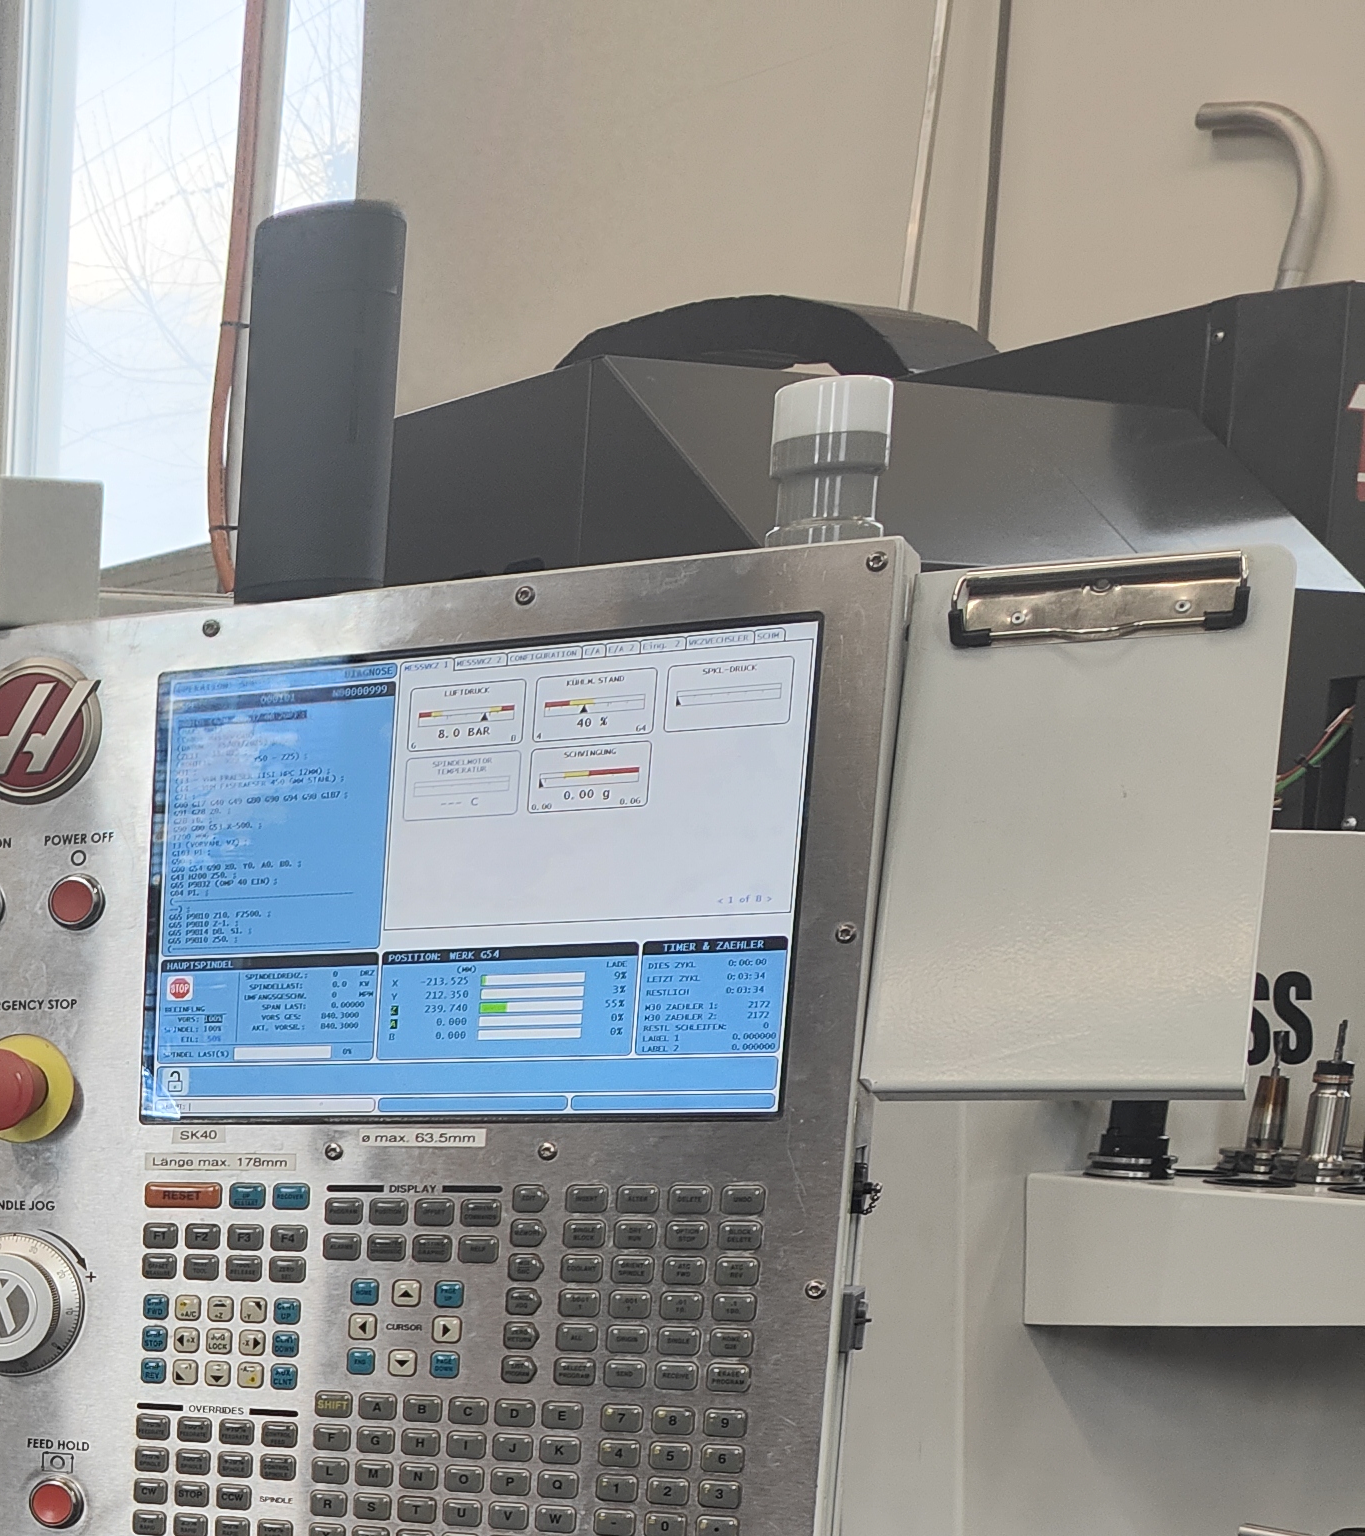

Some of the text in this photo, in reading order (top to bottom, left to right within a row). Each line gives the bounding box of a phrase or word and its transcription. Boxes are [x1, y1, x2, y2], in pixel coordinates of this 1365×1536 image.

[509, 650, 577, 662] CONFIGURATION
[344, 666, 393, 679] DIAGNOSE
[702, 664, 758, 675] SPKL-DRUCK
[598, 675, 625, 683] STAND
[444, 687, 490, 697] LUFTDRUCK
[577, 716, 608, 727] 40 %
[437, 727, 490, 739] 8.0 BAR
[563, 747, 617, 759] SCHWINGUNG
[432, 757, 492, 768] SPINDELMOTOR
[437, 766, 487, 775] TEMPERATUR
[564, 789, 610, 800] 0.00 g
[531, 803, 552, 811] 0.00
[619, 798, 641, 806] 0.06
[44, 831, 114, 847] POWER OFF
[663, 940, 764, 952] TIMER & ZAEHLER
[388, 950, 499, 962] POSITION: WERK G54
[167, 960, 233, 970] HAUPTSPINDEL
[648, 961, 696, 970] DIES ZYKL
[728, 958, 767, 967] 0:00:00
[614, 971, 627, 980] 9%
[647, 975, 673, 983] LETZT
[727, 973, 766, 981] 0:03:34
[392, 979, 398, 987] X
[421, 977, 469, 986] -213.525
[169, 983, 189, 994] STOP
[613, 985, 626, 994] 3%
[726, 986, 764, 994] 0:03:34
[391, 993, 398, 1001] Y
[425, 990, 469, 999] 212.350
[47, 998, 78, 1010] STOP
[284, 1002, 306, 1010] LAST:
[424, 1004, 468, 1013] 239.740
[605, 999, 625, 1008] 55%
[748, 1001, 770, 1009] 2172
[320, 1011, 359, 1019] 840.3000
[611, 1013, 624, 1022] 0%
[747, 1011, 770, 1019] 2172
[320, 1021, 359, 1030] 840.3000
[436, 1017, 467, 1026] 0.000
[435, 1031, 466, 1040] 0.000
[610, 1027, 623, 1036] 0%
[642, 1045, 668, 1053] LABEL
[179, 1129, 218, 1141] SK40
[374, 1133, 410, 1144] max.
[415, 1132, 476, 1143] 63.5mm
[152, 1157, 288, 1168] Länge max. 178mm
[388, 1184, 437, 1194] DISPLAY
[162, 1190, 201, 1200] RESET
[28, 1200, 56, 1212] JOG
[153, 1230, 167, 1241] F1
[194, 1232, 209, 1242] F2
[237, 1232, 251, 1243] F3
[280, 1233, 295, 1243] F4
[385, 1323, 423, 1332] CURSOR
[208, 1342, 228, 1351] LOCK
[188, 1404, 245, 1416] OVERRIDES
[317, 1400, 348, 1410] SHIFT
[372, 1402, 382, 1412] A
[417, 1404, 427, 1414] B
[463, 1406, 473, 1417] C
[509, 1408, 520, 1419] D
[557, 1410, 567, 1421] E
[617, 1412, 626, 1424] 7
[668, 1415, 677, 1426] 8
[721, 1417, 730, 1429] 9
[327, 1432, 336, 1443] F
[370, 1435, 380, 1446] G
[415, 1438, 425, 1448] H
[26, 1437, 90, 1452] FEED HOLD
[464, 1441, 467, 1450] I
[508, 1443, 517, 1453] J
[554, 1445, 564, 1456] K
[614, 1448, 623, 1459] 4
[666, 1450, 675, 1462] 5
[718, 1453, 727, 1464] 6
[325, 1466, 334, 1476] L
[368, 1468, 379, 1479] M
[413, 1471, 423, 1482] N
[458, 1474, 469, 1485] O
[505, 1476, 515, 1487] P
[552, 1479, 563, 1490] Q
[141, 1486, 157, 1495] CW
[178, 1489, 203, 1499] STOP
[613, 1483, 619, 1494] 1
[662, 1485, 672, 1497] 2
[715, 1488, 724, 1500] 3
[221, 1492, 244, 1502] CCW
[259, 1495, 293, 1505] SPINDLE
[323, 1498, 332, 1509] R
[367, 1501, 376, 1512] S
[411, 1504, 421, 1515] T
[457, 1507, 467, 1518] U
[503, 1510, 513, 1521] V
[549, 1513, 563, 1525] W
[660, 1520, 670, 1532] 0
